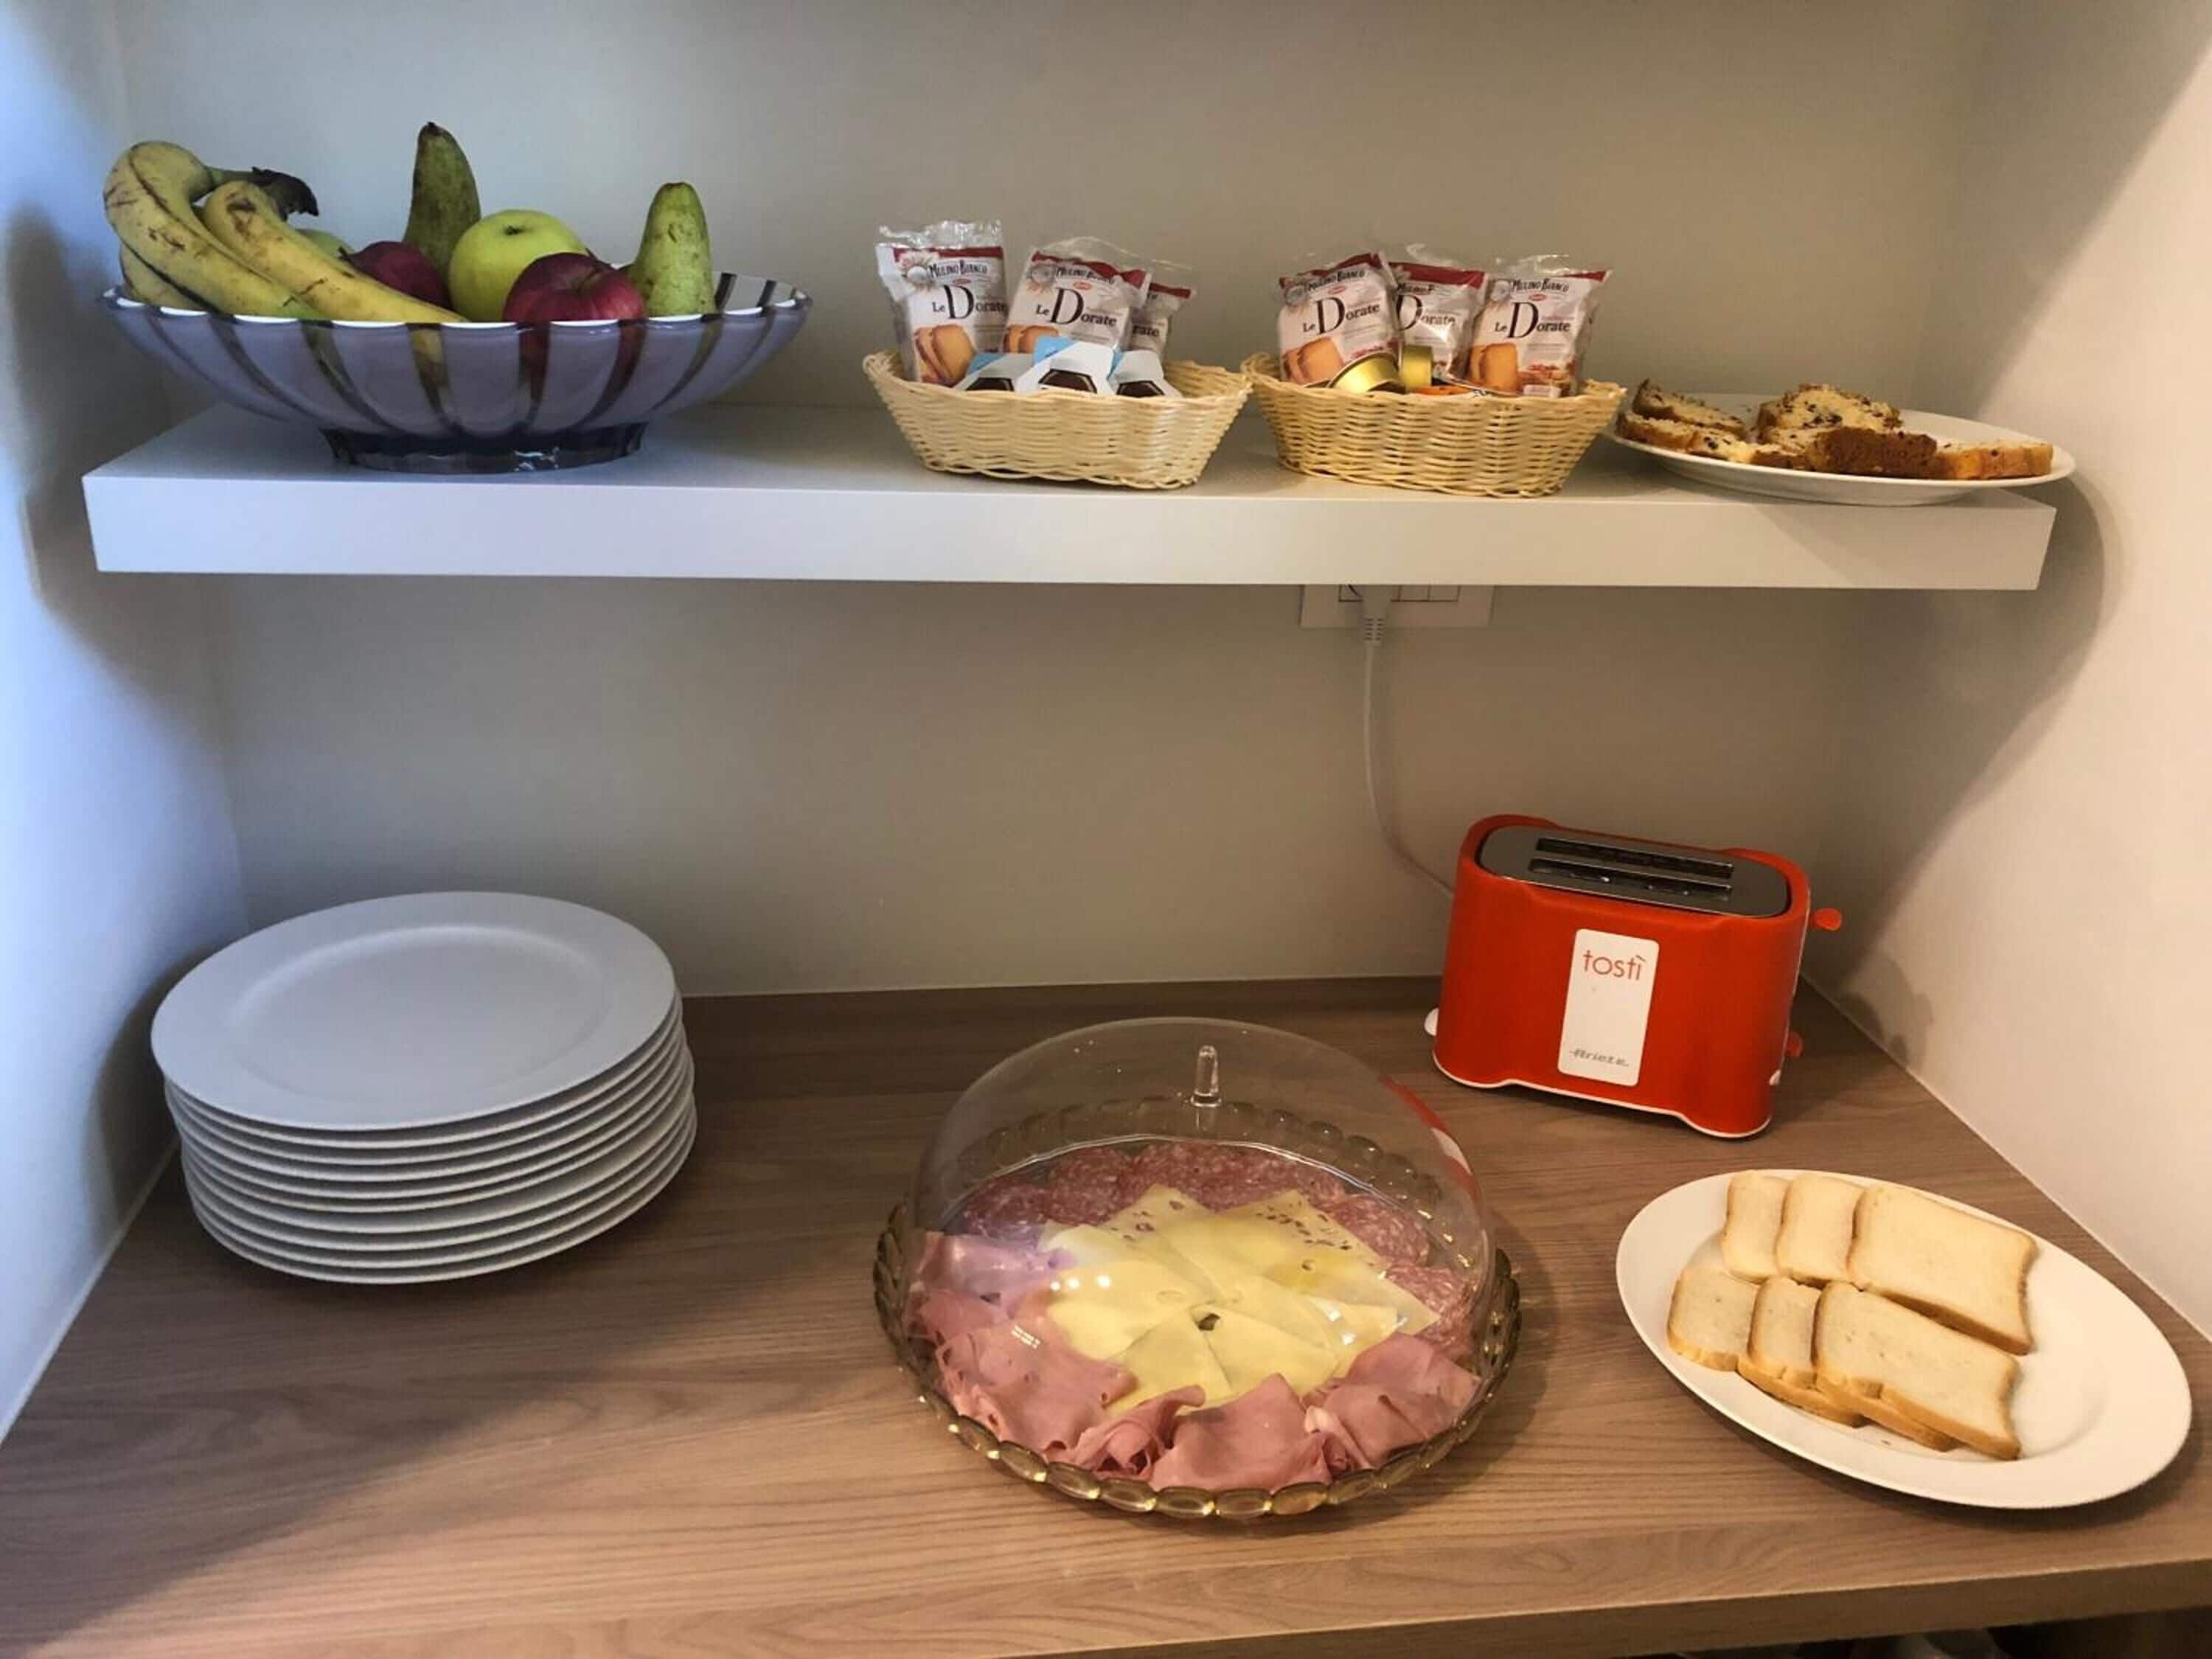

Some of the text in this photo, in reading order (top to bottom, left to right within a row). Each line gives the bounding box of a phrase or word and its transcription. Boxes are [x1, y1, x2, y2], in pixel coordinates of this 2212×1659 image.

[932, 302, 945, 313] Le
[1036, 305, 1050, 316] Le
[1048, 288, 1118, 326] Dorate
[1303, 322, 1316, 333] Le
[1315, 296, 1380, 335] Dorate
[1495, 301, 1571, 339] Le Dorate
[1133, 324, 1161, 337] rate
